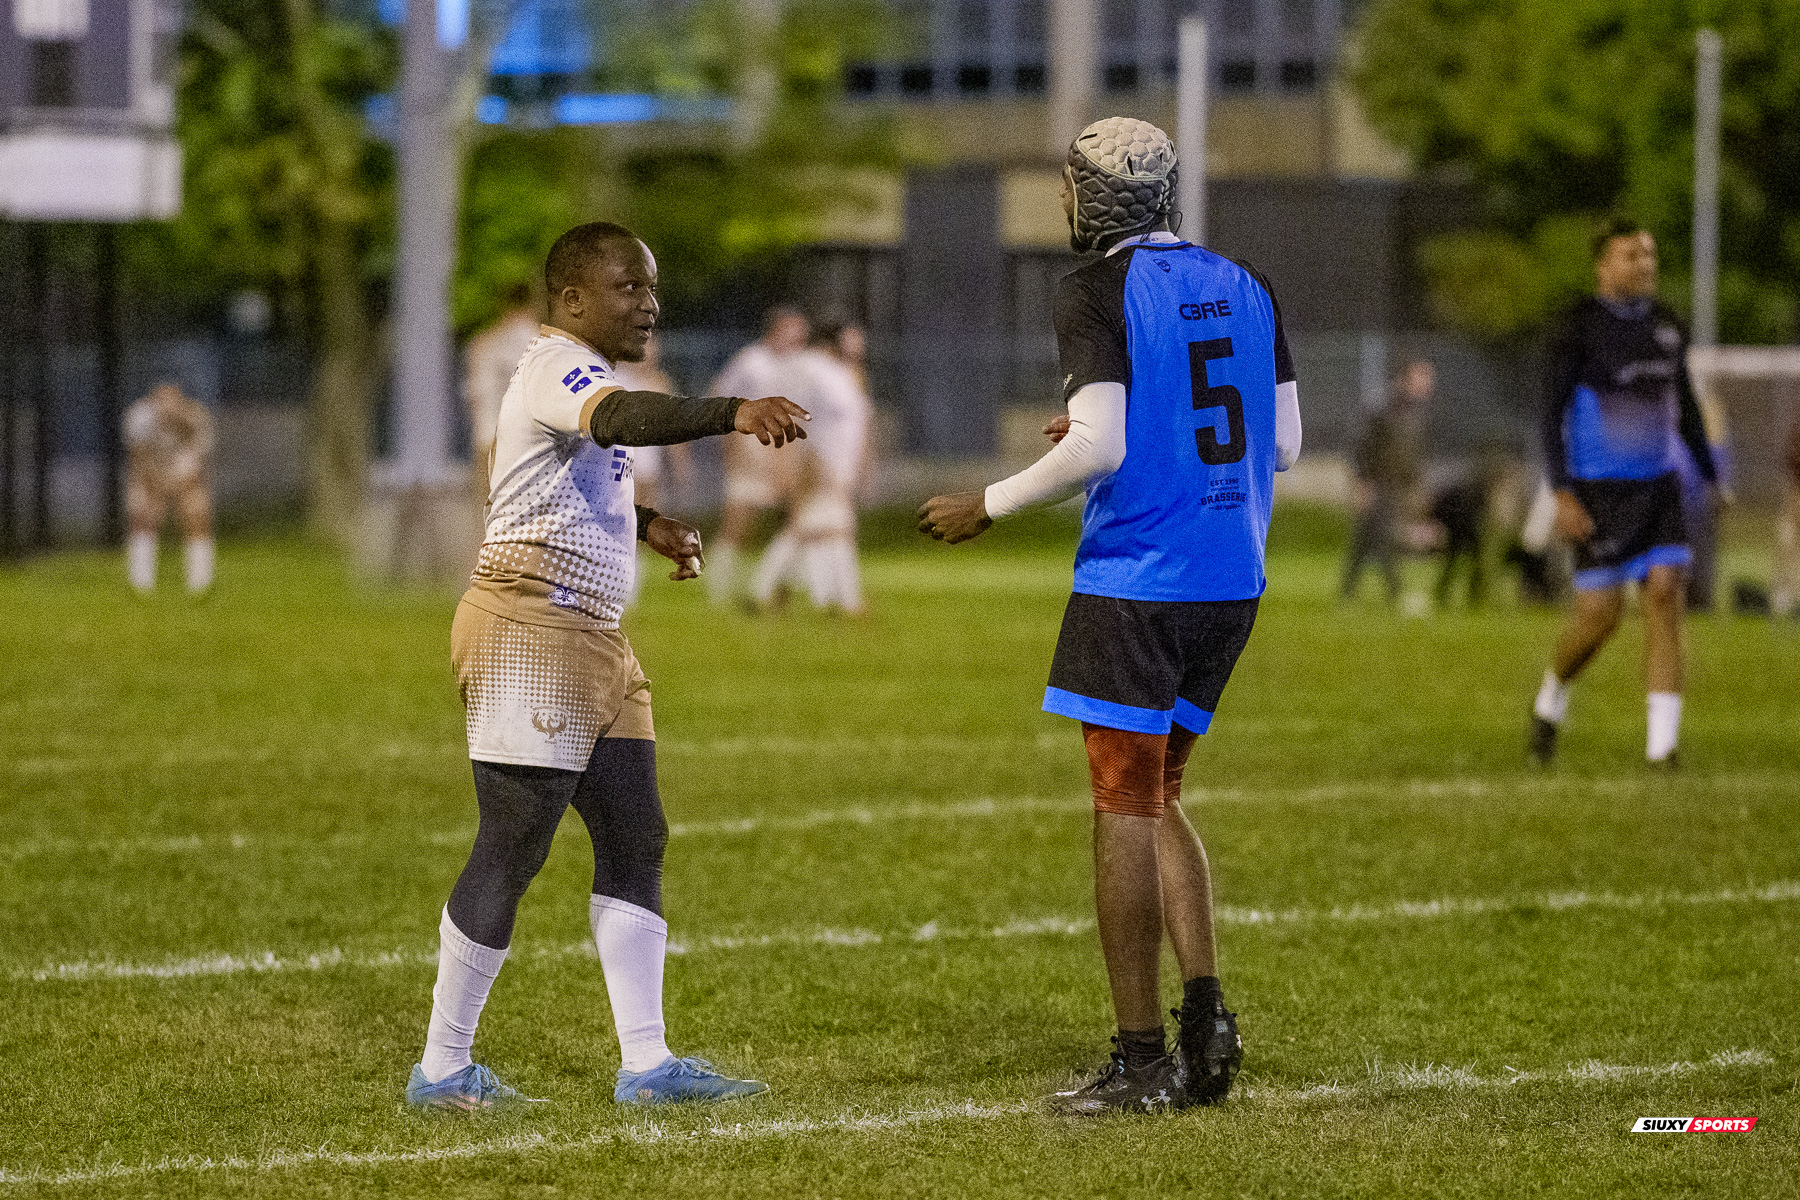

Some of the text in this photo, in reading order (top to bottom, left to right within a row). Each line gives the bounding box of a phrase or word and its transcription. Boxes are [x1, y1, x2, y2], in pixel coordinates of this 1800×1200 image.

[1179, 300, 1232, 320] CBRE
[1188, 337, 1246, 465] 5
[1200, 492, 1246, 505] BRASSERIE
